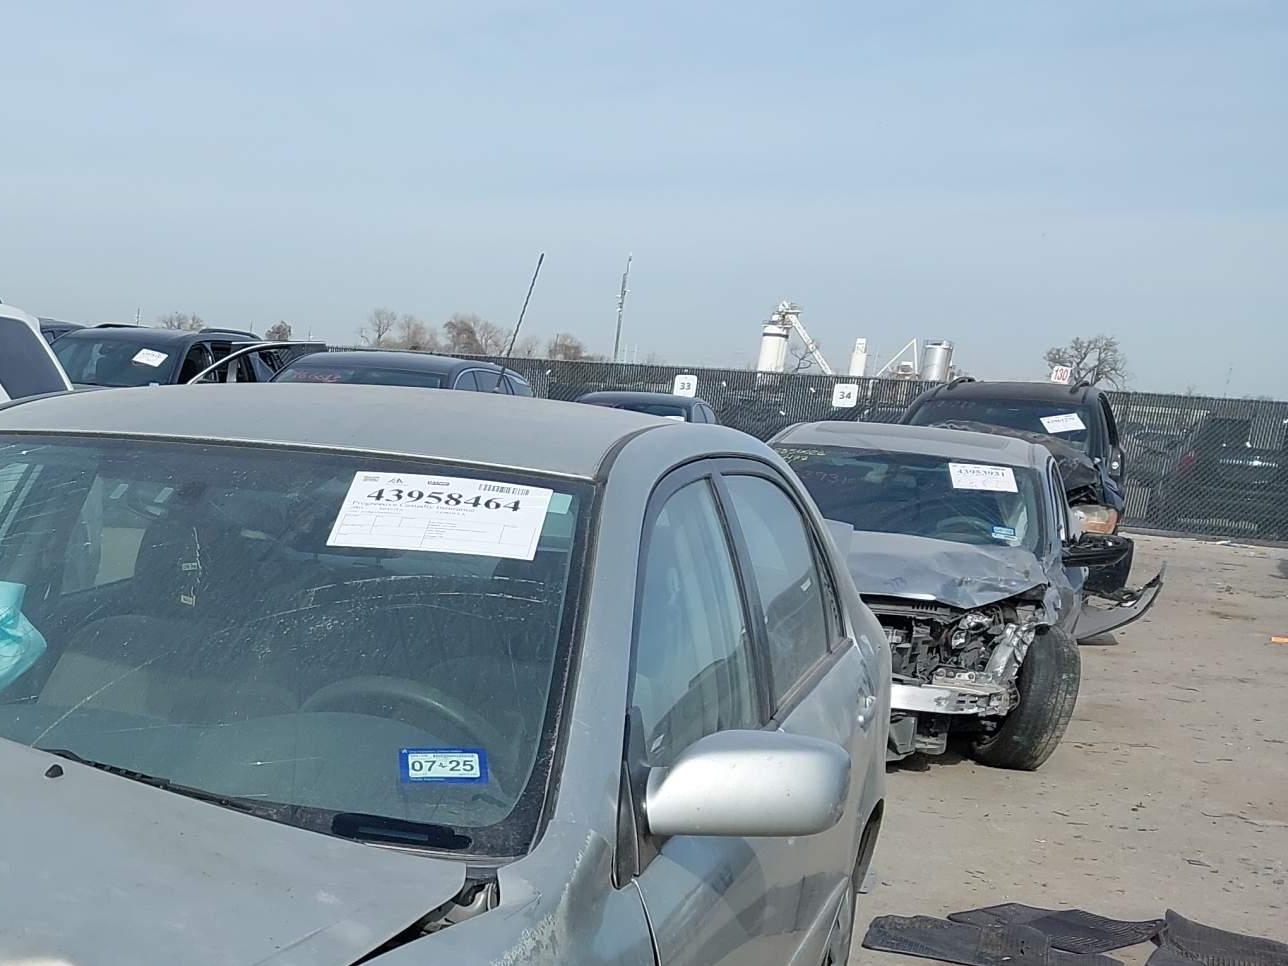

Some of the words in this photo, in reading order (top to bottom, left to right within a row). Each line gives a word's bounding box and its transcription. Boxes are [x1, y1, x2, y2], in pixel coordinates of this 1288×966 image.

[1054, 368, 1069, 381] 130
[679, 382, 692, 391] 33
[839, 391, 852, 400] 34
[366, 488, 521, 512] 43958464
[411, 760, 436, 772] 07
[449, 759, 474, 772] 25
